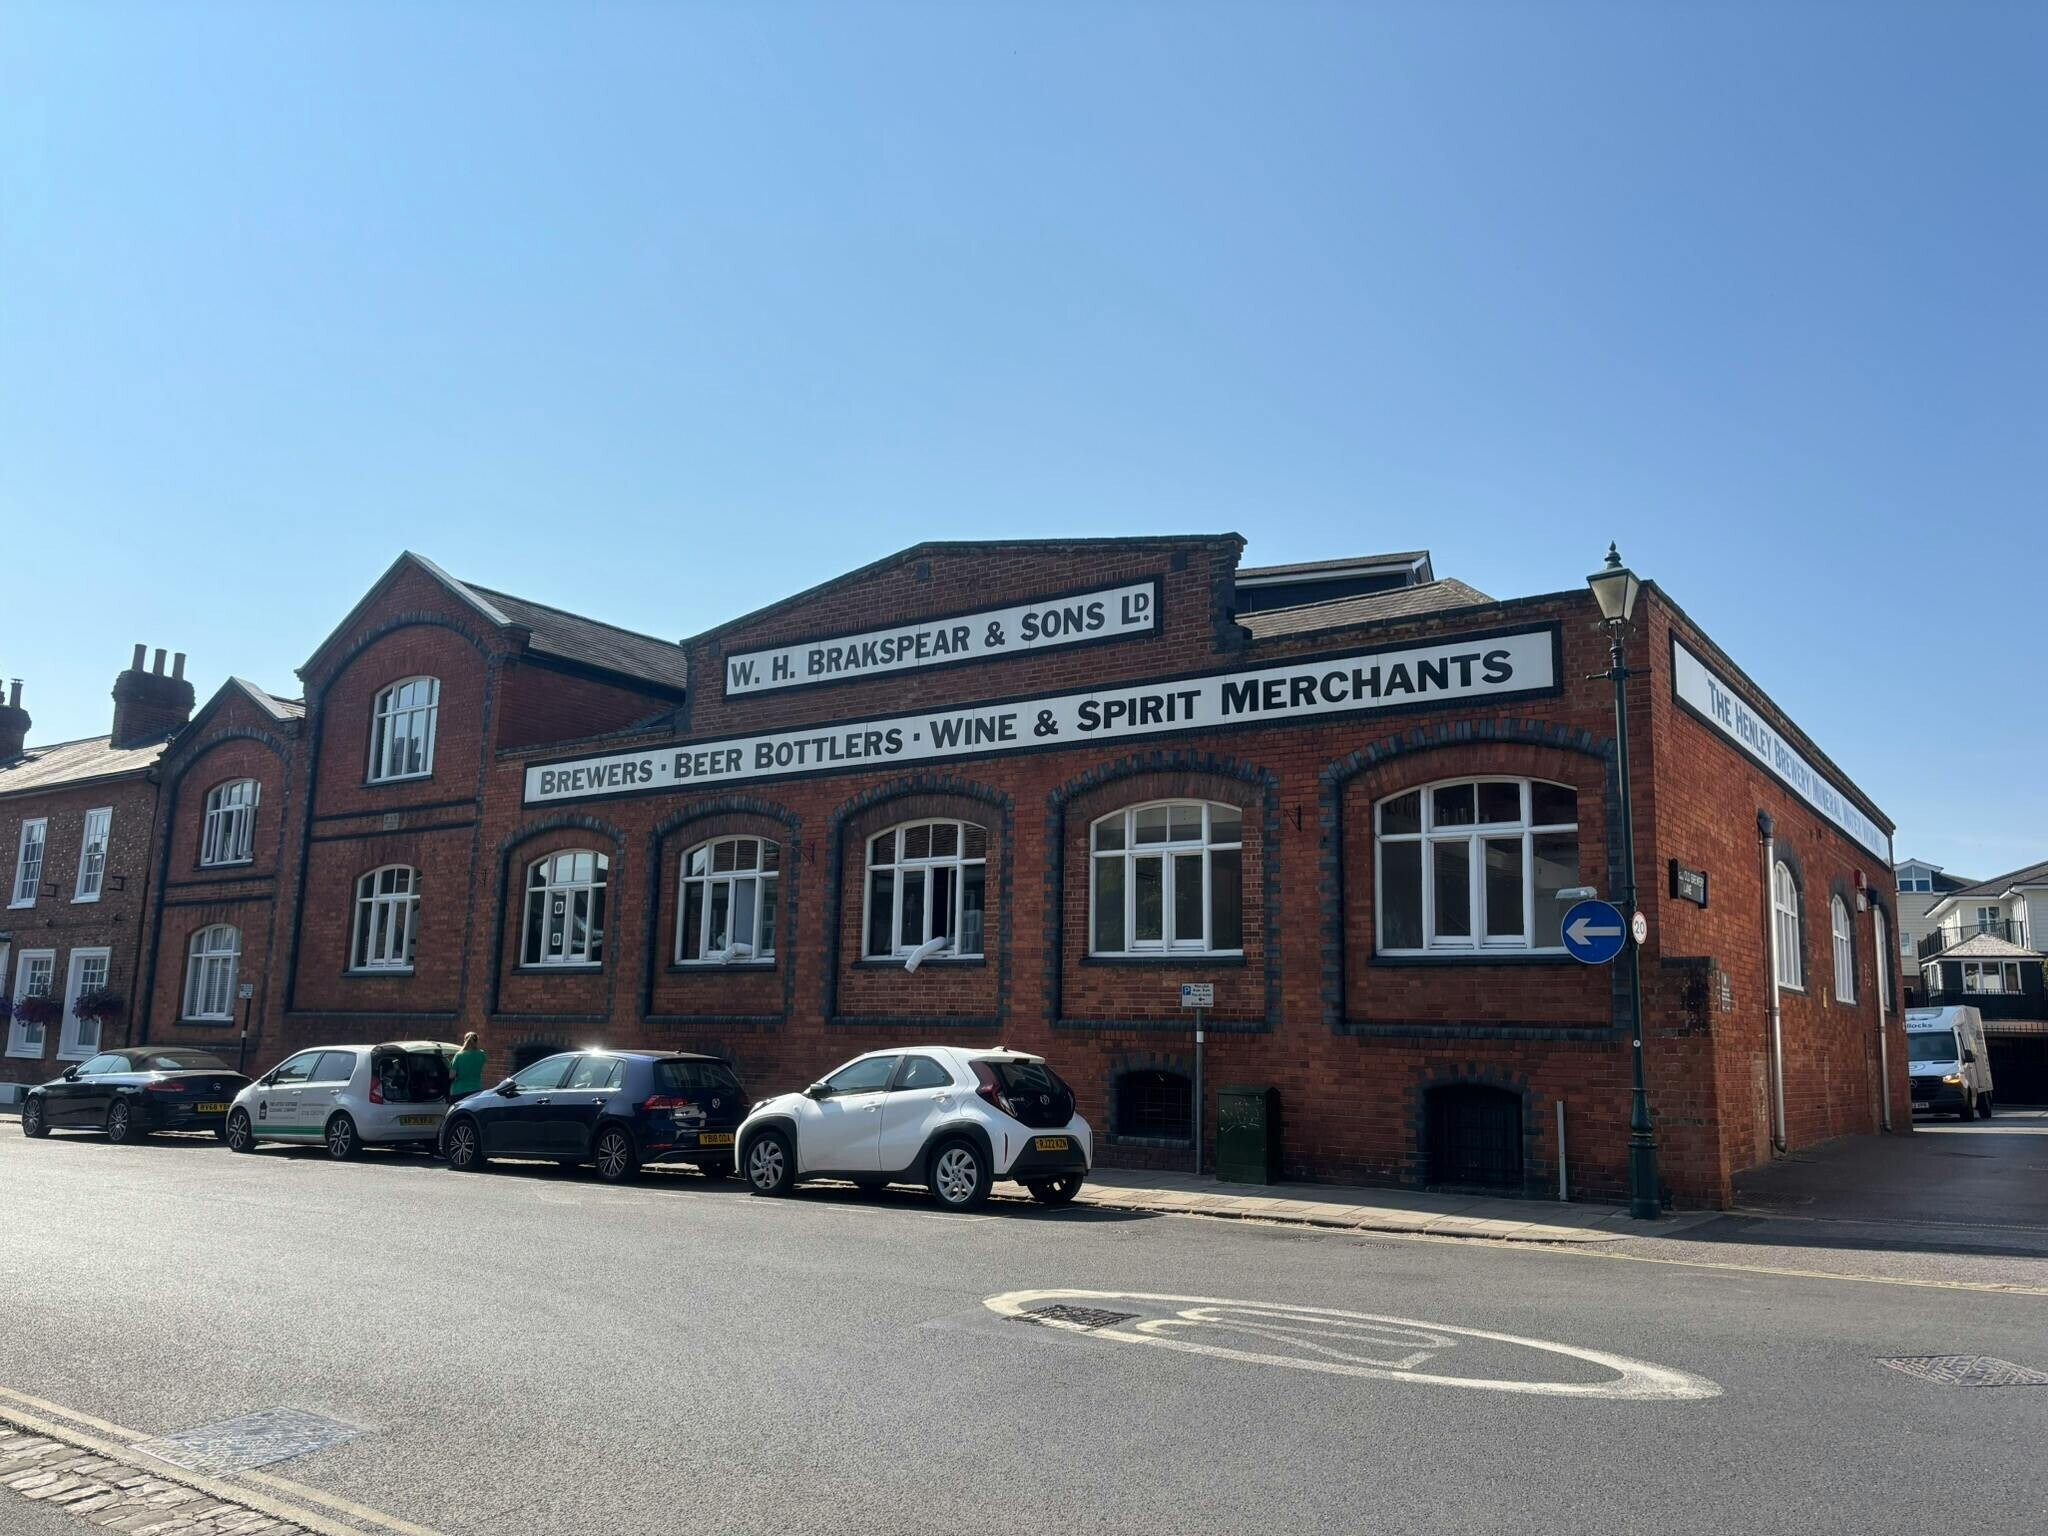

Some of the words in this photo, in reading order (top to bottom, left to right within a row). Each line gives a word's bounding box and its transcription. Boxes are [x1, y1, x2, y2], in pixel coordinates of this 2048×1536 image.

[731, 660, 760, 687] W.
[772, 655, 796, 681] H.
[808, 625, 970, 676] BRAKSPEAR
[984, 620, 1005, 648] &
[1020, 602, 1106, 641] SONS
[540, 759, 653, 795] BREWERS
[674, 748, 743, 778] BEER
[754, 728, 903, 770] BOTTLERS
[930, 713, 1017, 749] WINE
[1033, 709, 1059, 737] &
[1076, 690, 1202, 731] SPIRIT
[1221, 650, 1513, 716] MERCHANTS
[1708, 679, 1731, 728] THE
[1735, 702, 1771, 761] HENLEY
[1774, 738, 1810, 796] BREWERY
[1634, 920, 1645, 935] 20
[1136, 1307, 1457, 1369] 20
